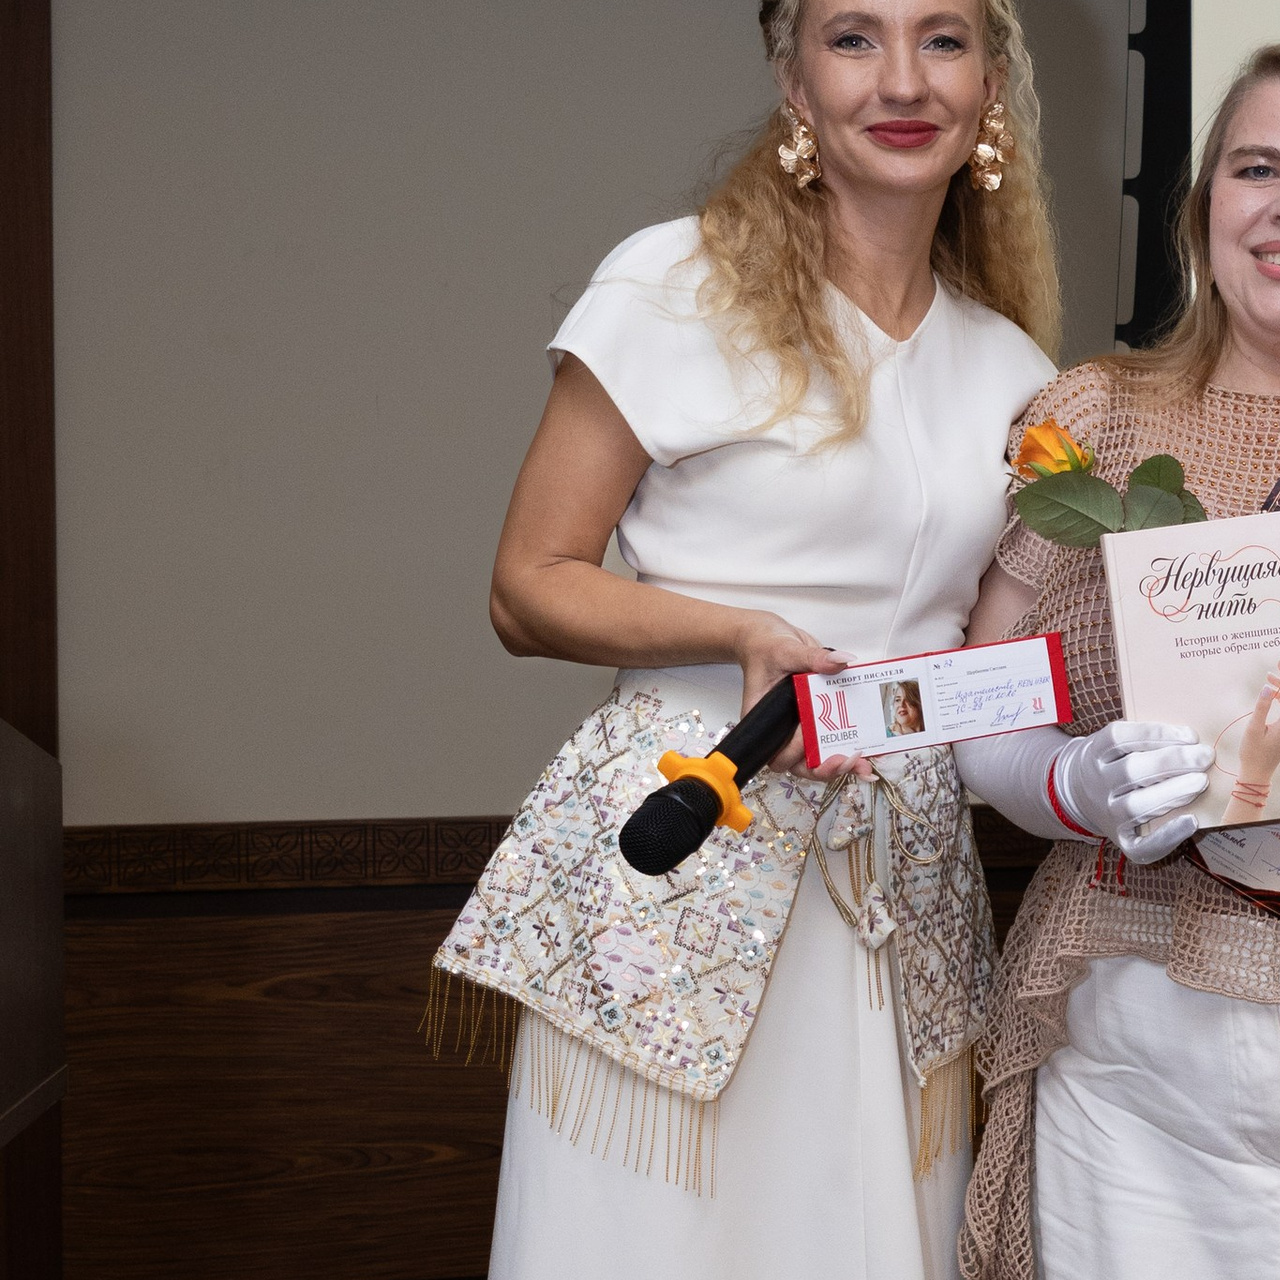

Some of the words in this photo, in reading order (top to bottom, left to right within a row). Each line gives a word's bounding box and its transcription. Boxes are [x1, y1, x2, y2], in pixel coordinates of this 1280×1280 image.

[1163, 592, 1259, 623] нить
[1174, 634, 1220, 648] Истории
[1222, 633, 1229, 642] о
[1179, 647, 1222, 660] которые
[1224, 641, 1261, 656] обрели
[826, 675, 862, 687] ПАСПОРТ
[864, 668, 905, 681] ПИСАТЕЛЯ
[819, 729, 859, 744] REDLIBER
